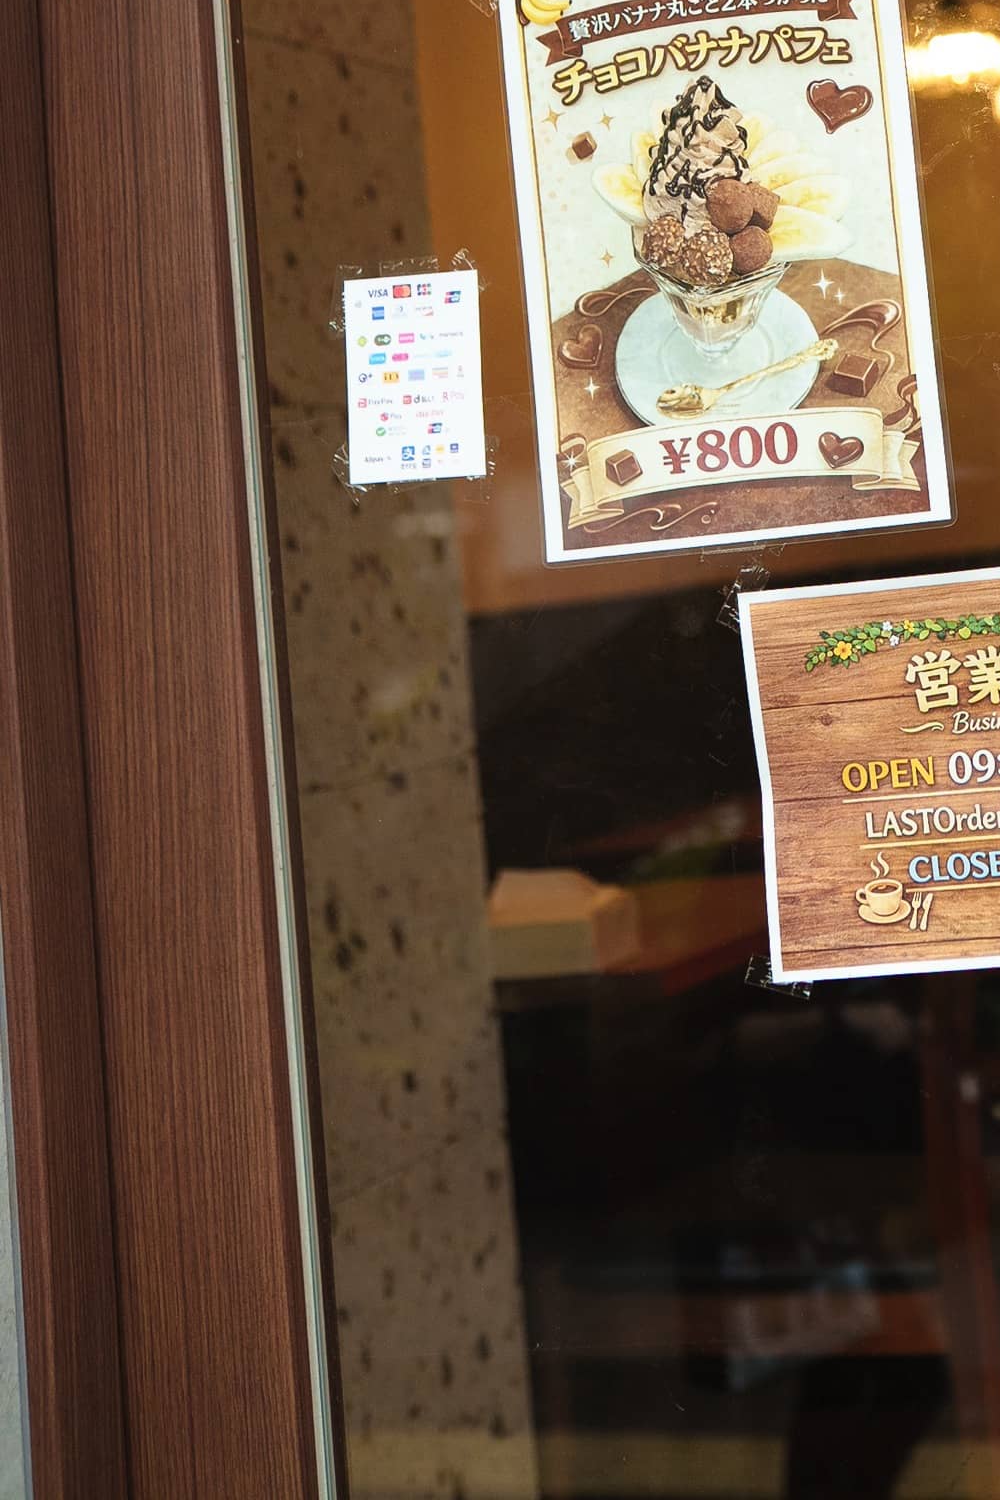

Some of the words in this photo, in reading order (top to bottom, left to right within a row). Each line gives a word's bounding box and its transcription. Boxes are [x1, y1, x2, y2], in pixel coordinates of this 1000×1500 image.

[554, 25, 853, 106] チョコバナナパフェ
[368, 288, 389, 298] VISA
[659, 421, 798, 475] ¥800
[841, 755, 935, 793] OPEN
